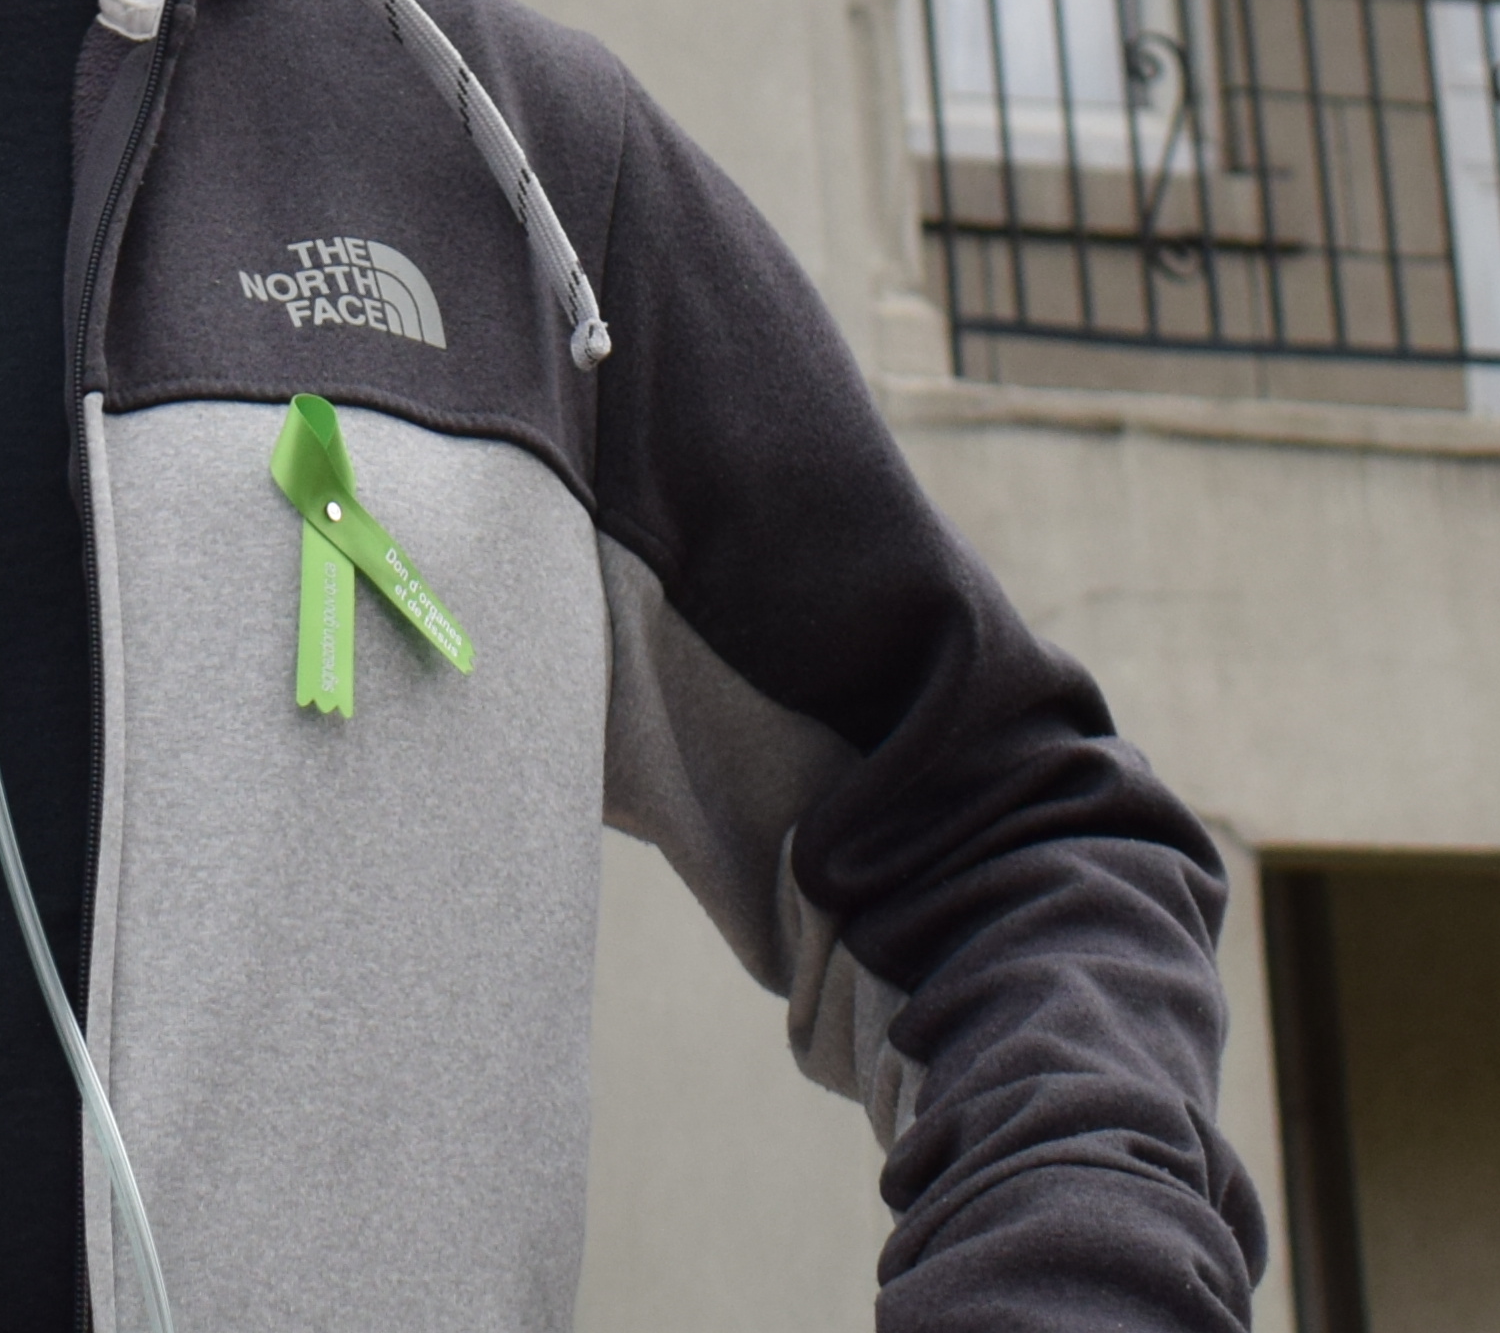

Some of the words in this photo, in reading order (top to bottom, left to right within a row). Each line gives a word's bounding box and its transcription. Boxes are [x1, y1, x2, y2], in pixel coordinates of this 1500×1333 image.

[287, 237, 371, 268] THE
[238, 266, 380, 302] NORTH
[286, 295, 388, 331] FACE
[385, 547, 409, 581] Don
[395, 584, 407, 600] et
[408, 599, 422, 617] de
